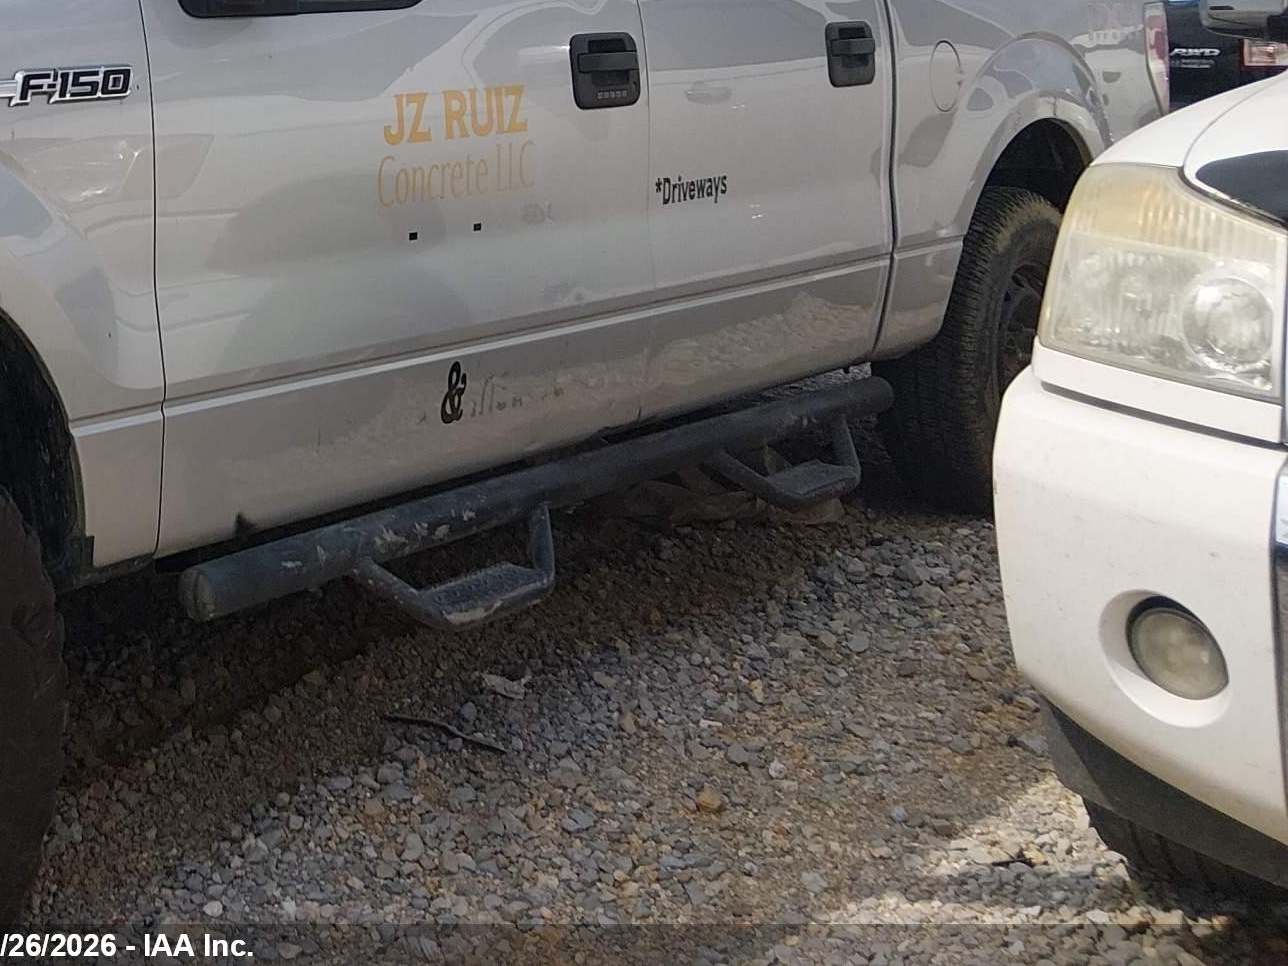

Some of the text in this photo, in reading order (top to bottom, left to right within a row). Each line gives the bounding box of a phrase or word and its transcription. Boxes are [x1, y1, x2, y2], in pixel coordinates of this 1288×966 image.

[15, 66, 133, 104] F-150
[383, 84, 529, 146] JZ RUIZ
[376, 139, 535, 209] Concrete LLC
[440, 360, 468, 425] &
